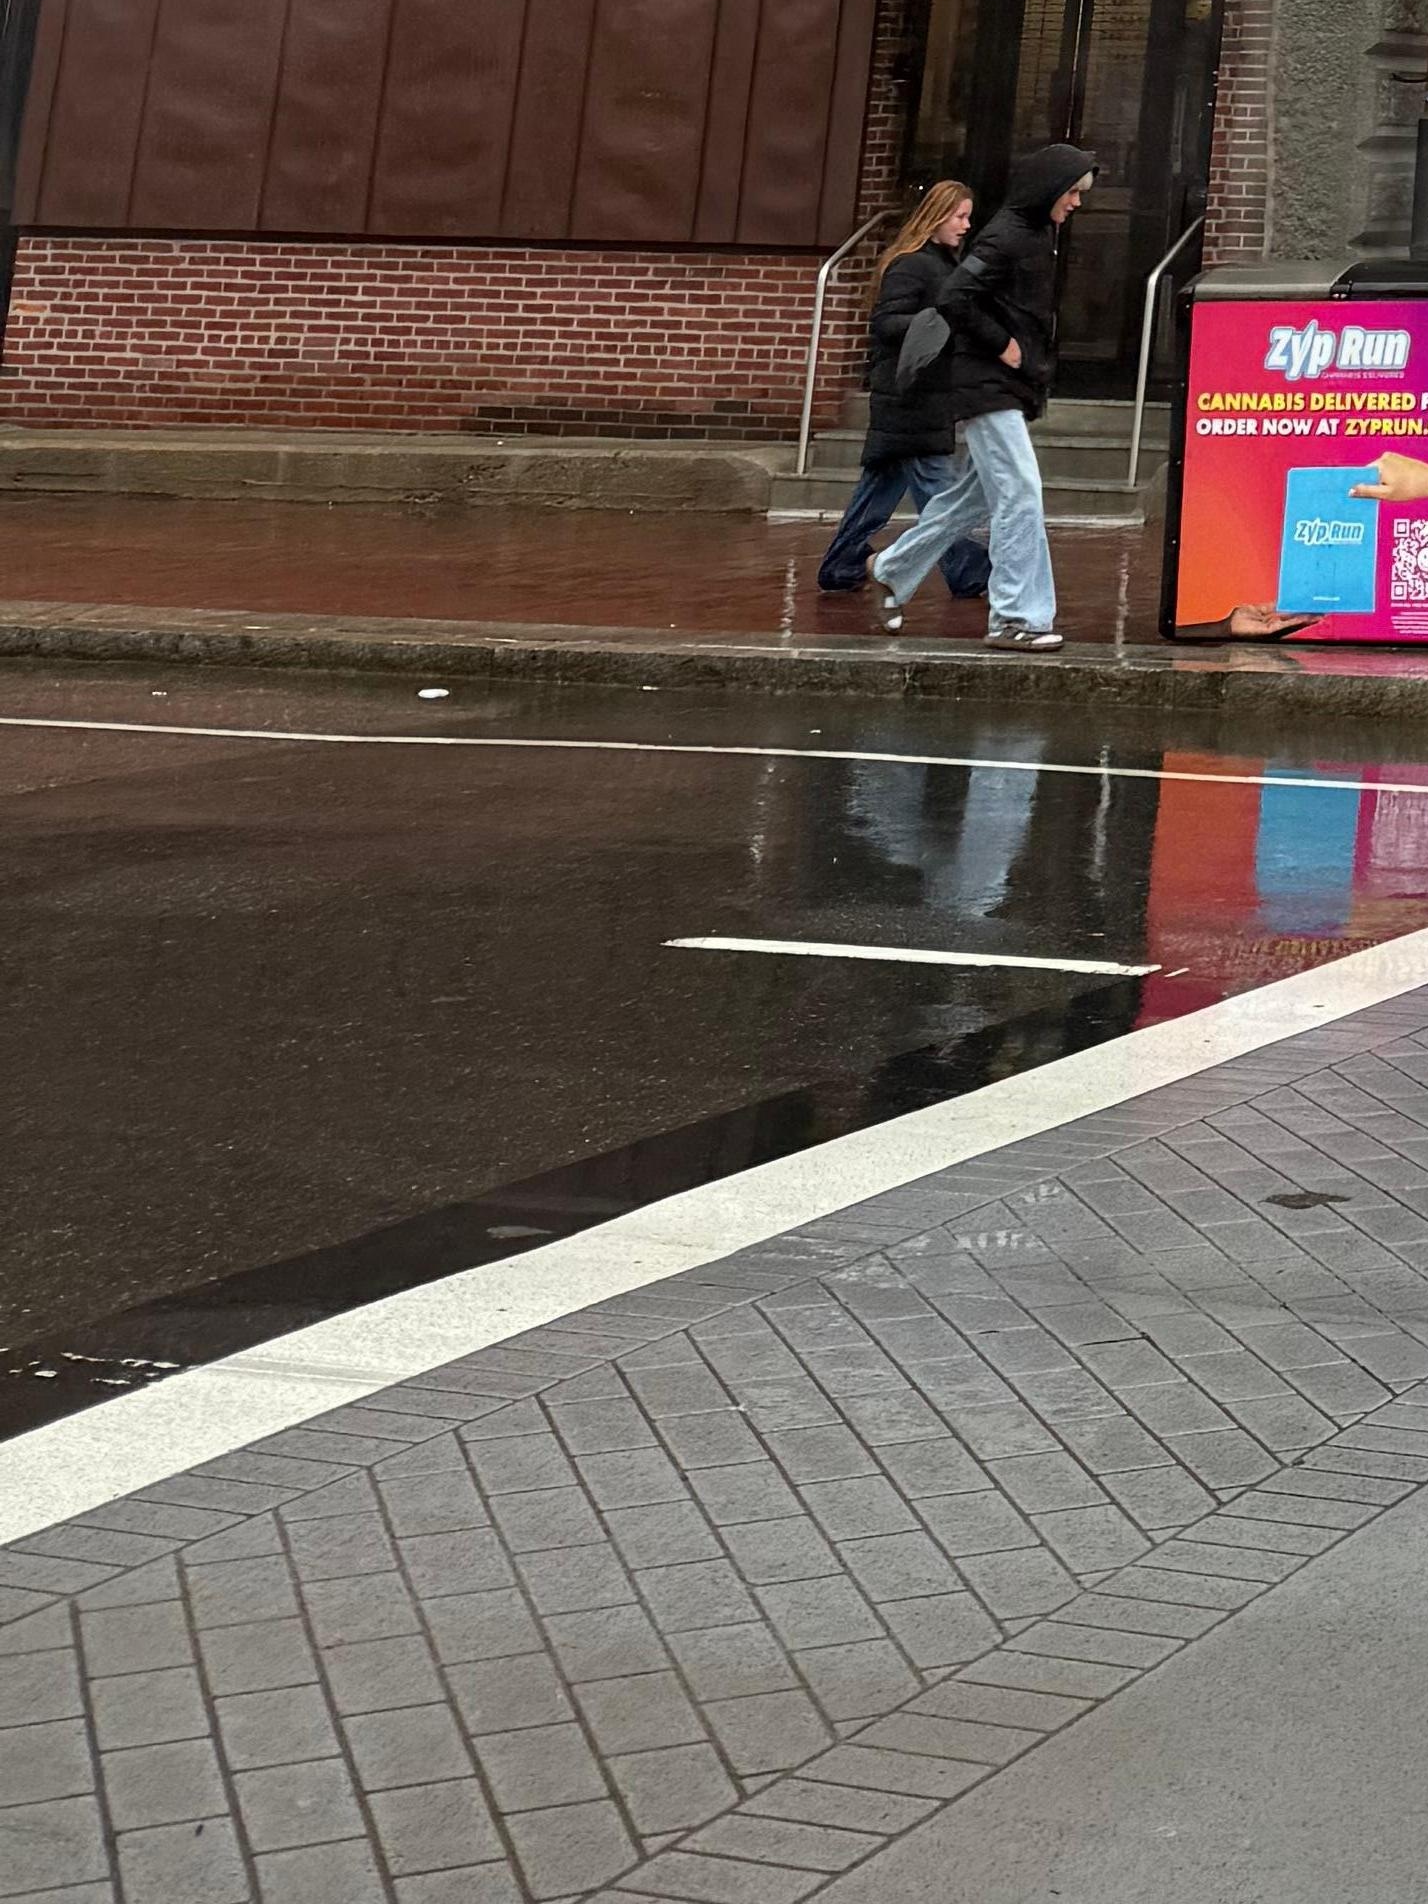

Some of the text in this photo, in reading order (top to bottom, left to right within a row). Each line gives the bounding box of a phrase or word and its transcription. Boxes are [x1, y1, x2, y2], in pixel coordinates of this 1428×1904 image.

[1265, 320, 1410, 379] Zyp Run
[1197, 393, 1305, 412] CANNABIS
[1309, 393, 1416, 411] DELIVERED
[1196, 419, 1257, 435] ORDER
[1262, 419, 1313, 435] NOW
[1315, 419, 1340, 435] AT
[1294, 517, 1365, 545] Zyp Run
